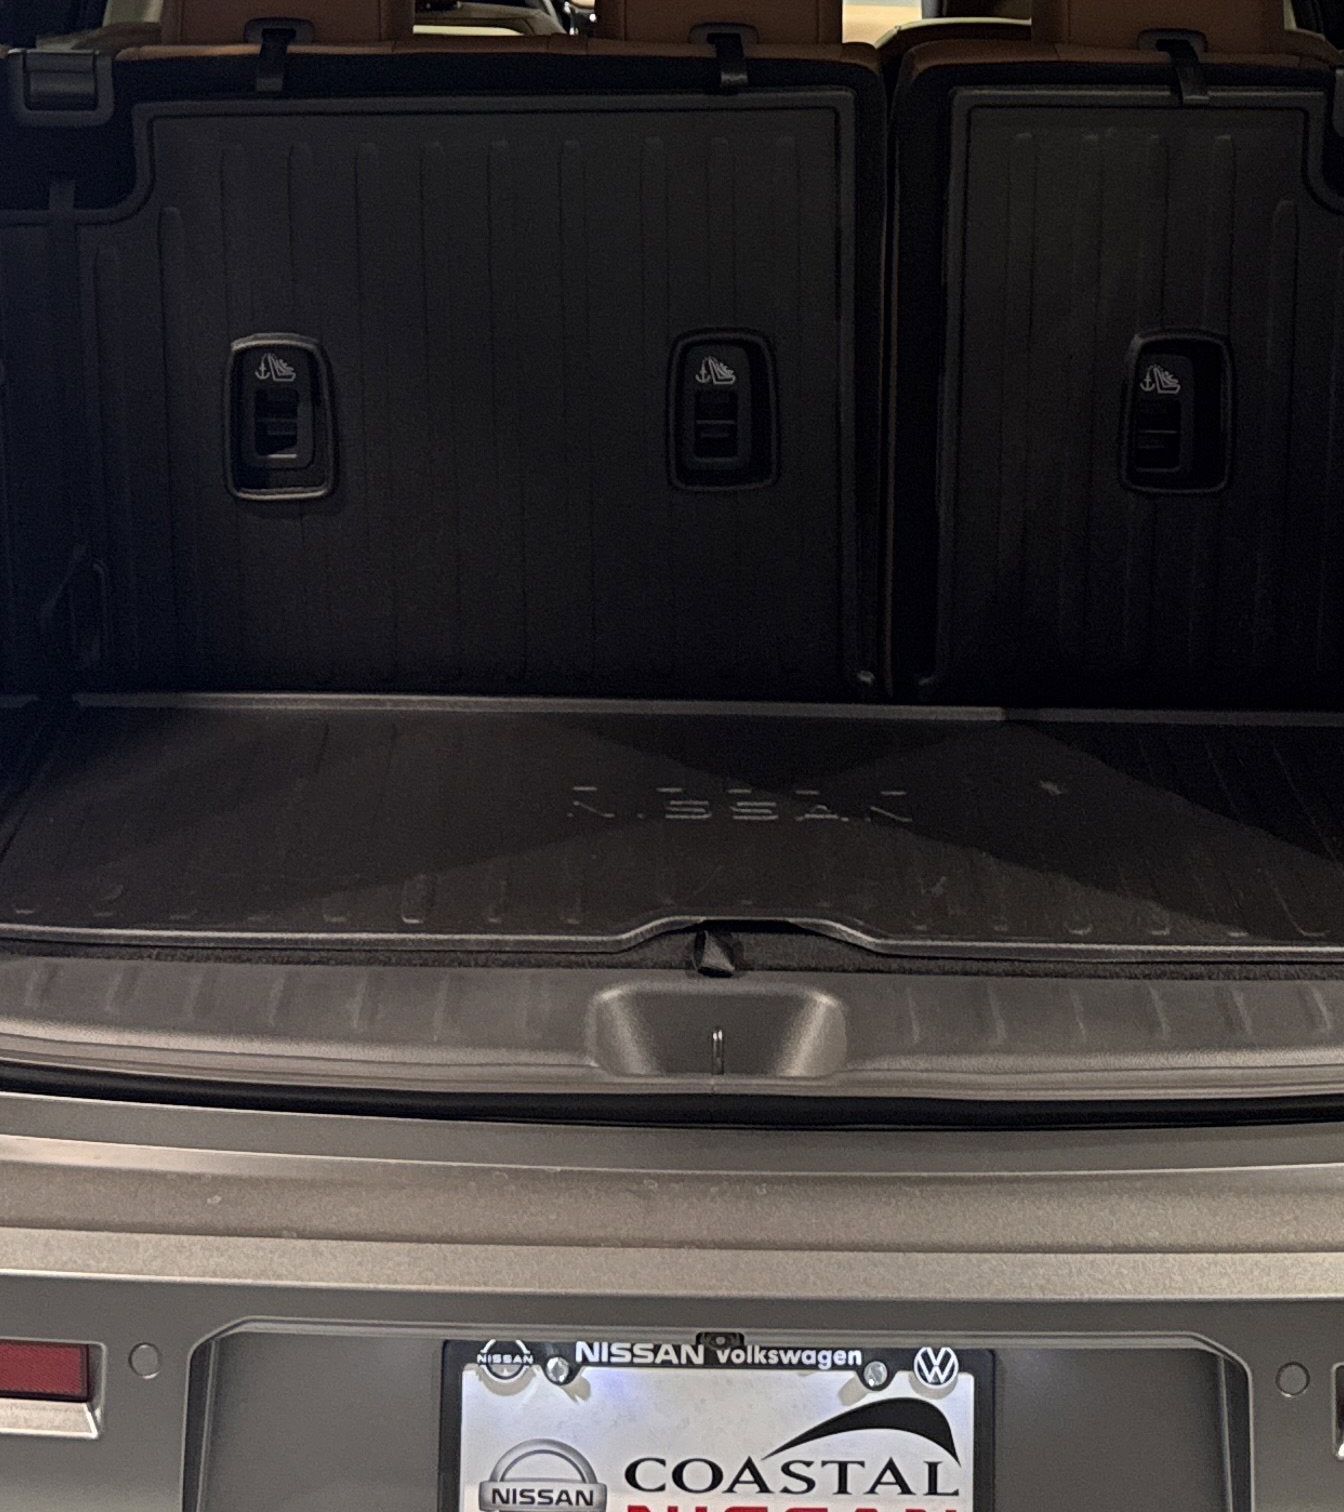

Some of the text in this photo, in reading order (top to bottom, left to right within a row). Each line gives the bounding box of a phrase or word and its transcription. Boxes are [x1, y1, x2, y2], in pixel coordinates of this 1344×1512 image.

[567, 799, 913, 821] NSSAN
[477, 1353, 534, 1364] NISSAN
[575, 1341, 704, 1364] NISSAN
[914, 1347, 958, 1387] VW
[625, 1456, 959, 1495] COASTAL
[492, 1488, 594, 1506] NISSAN
